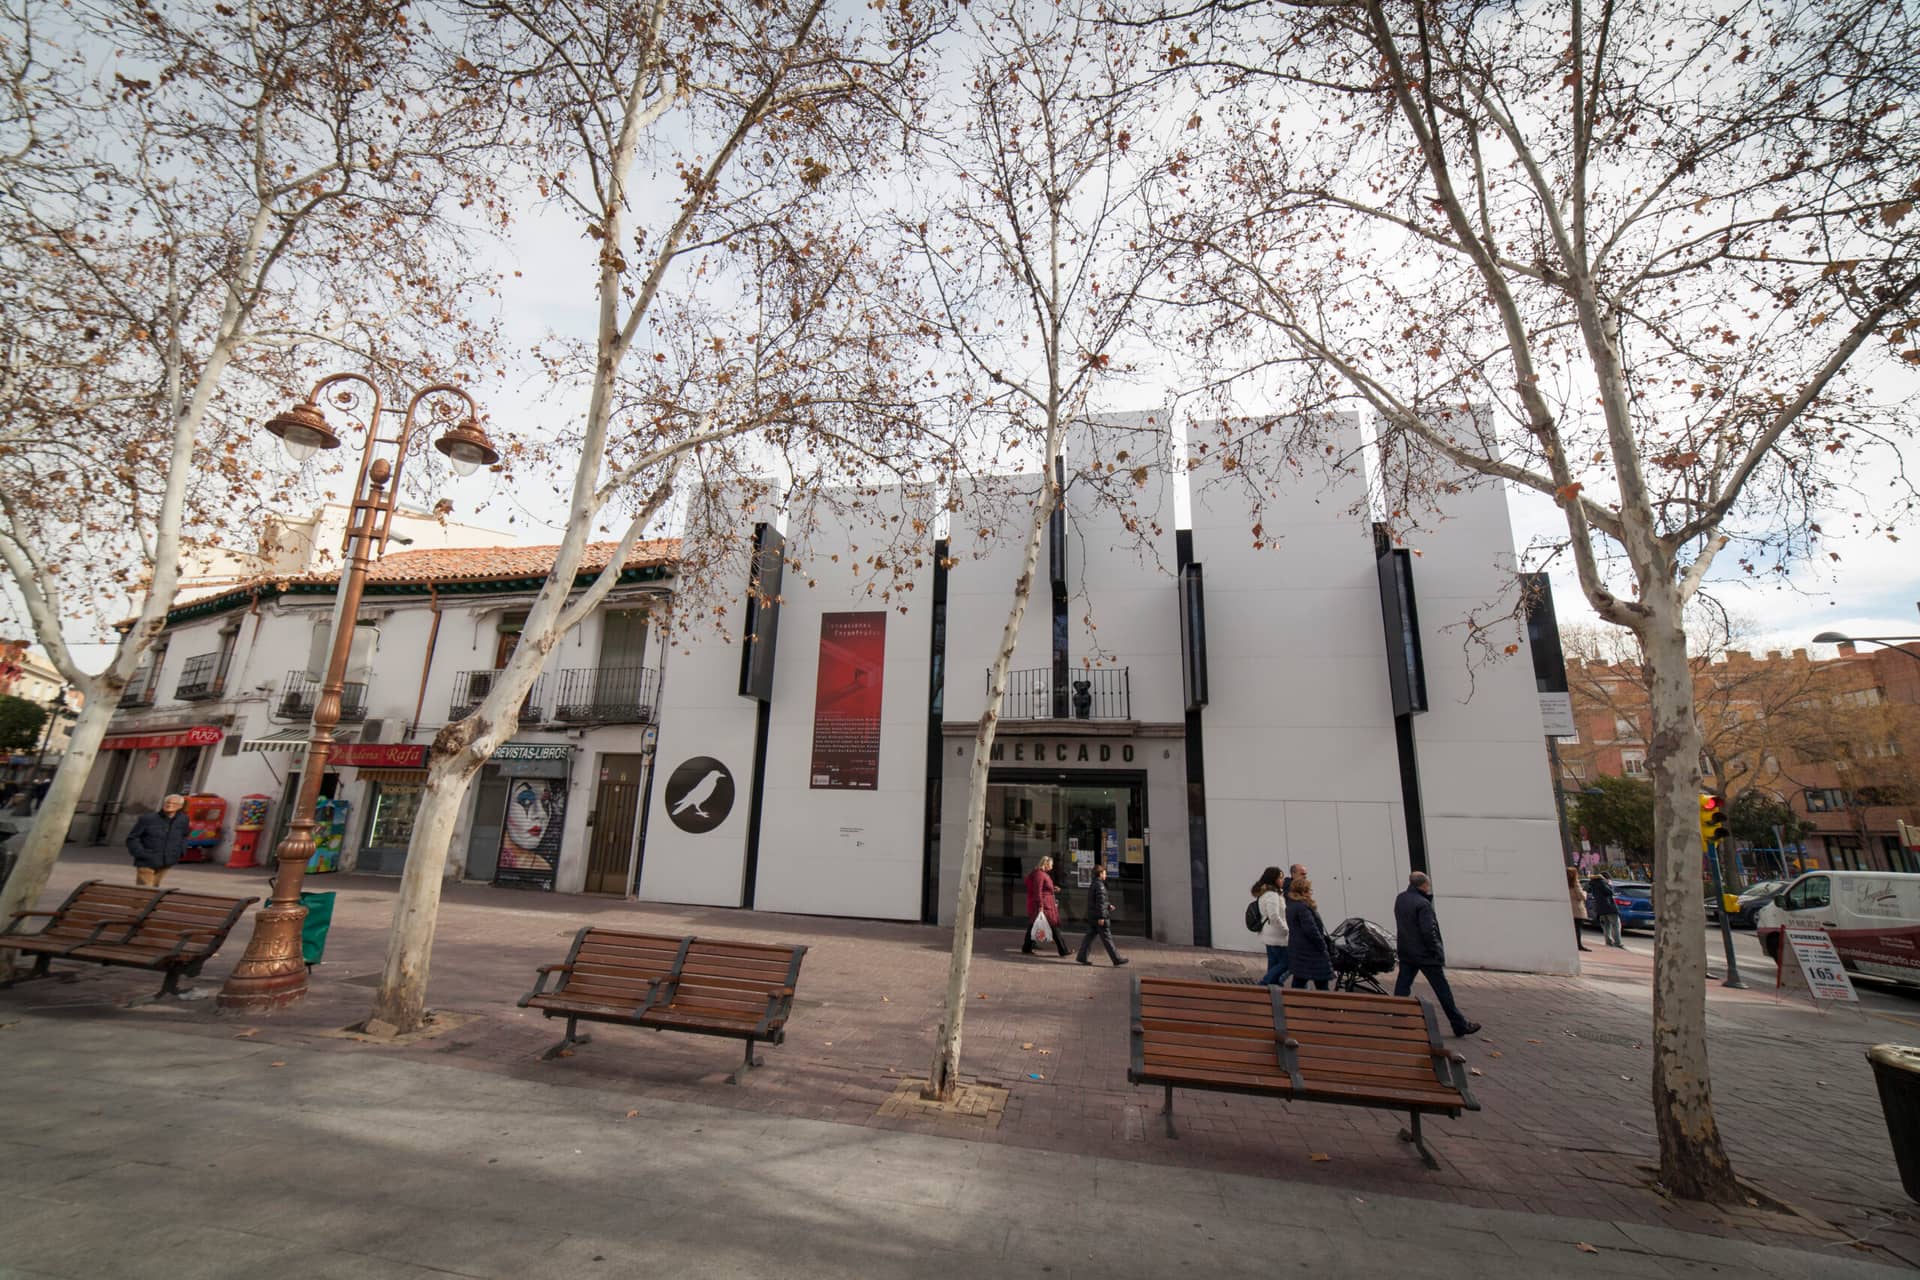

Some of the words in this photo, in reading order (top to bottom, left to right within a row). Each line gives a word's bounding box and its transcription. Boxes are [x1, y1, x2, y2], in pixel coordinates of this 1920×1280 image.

[191, 730, 220, 741] PLAZA
[386, 746, 420, 765] Rafa
[494, 747, 567, 759] REVISTAS-LIBROS
[990, 744, 1134, 762] MERCADO
